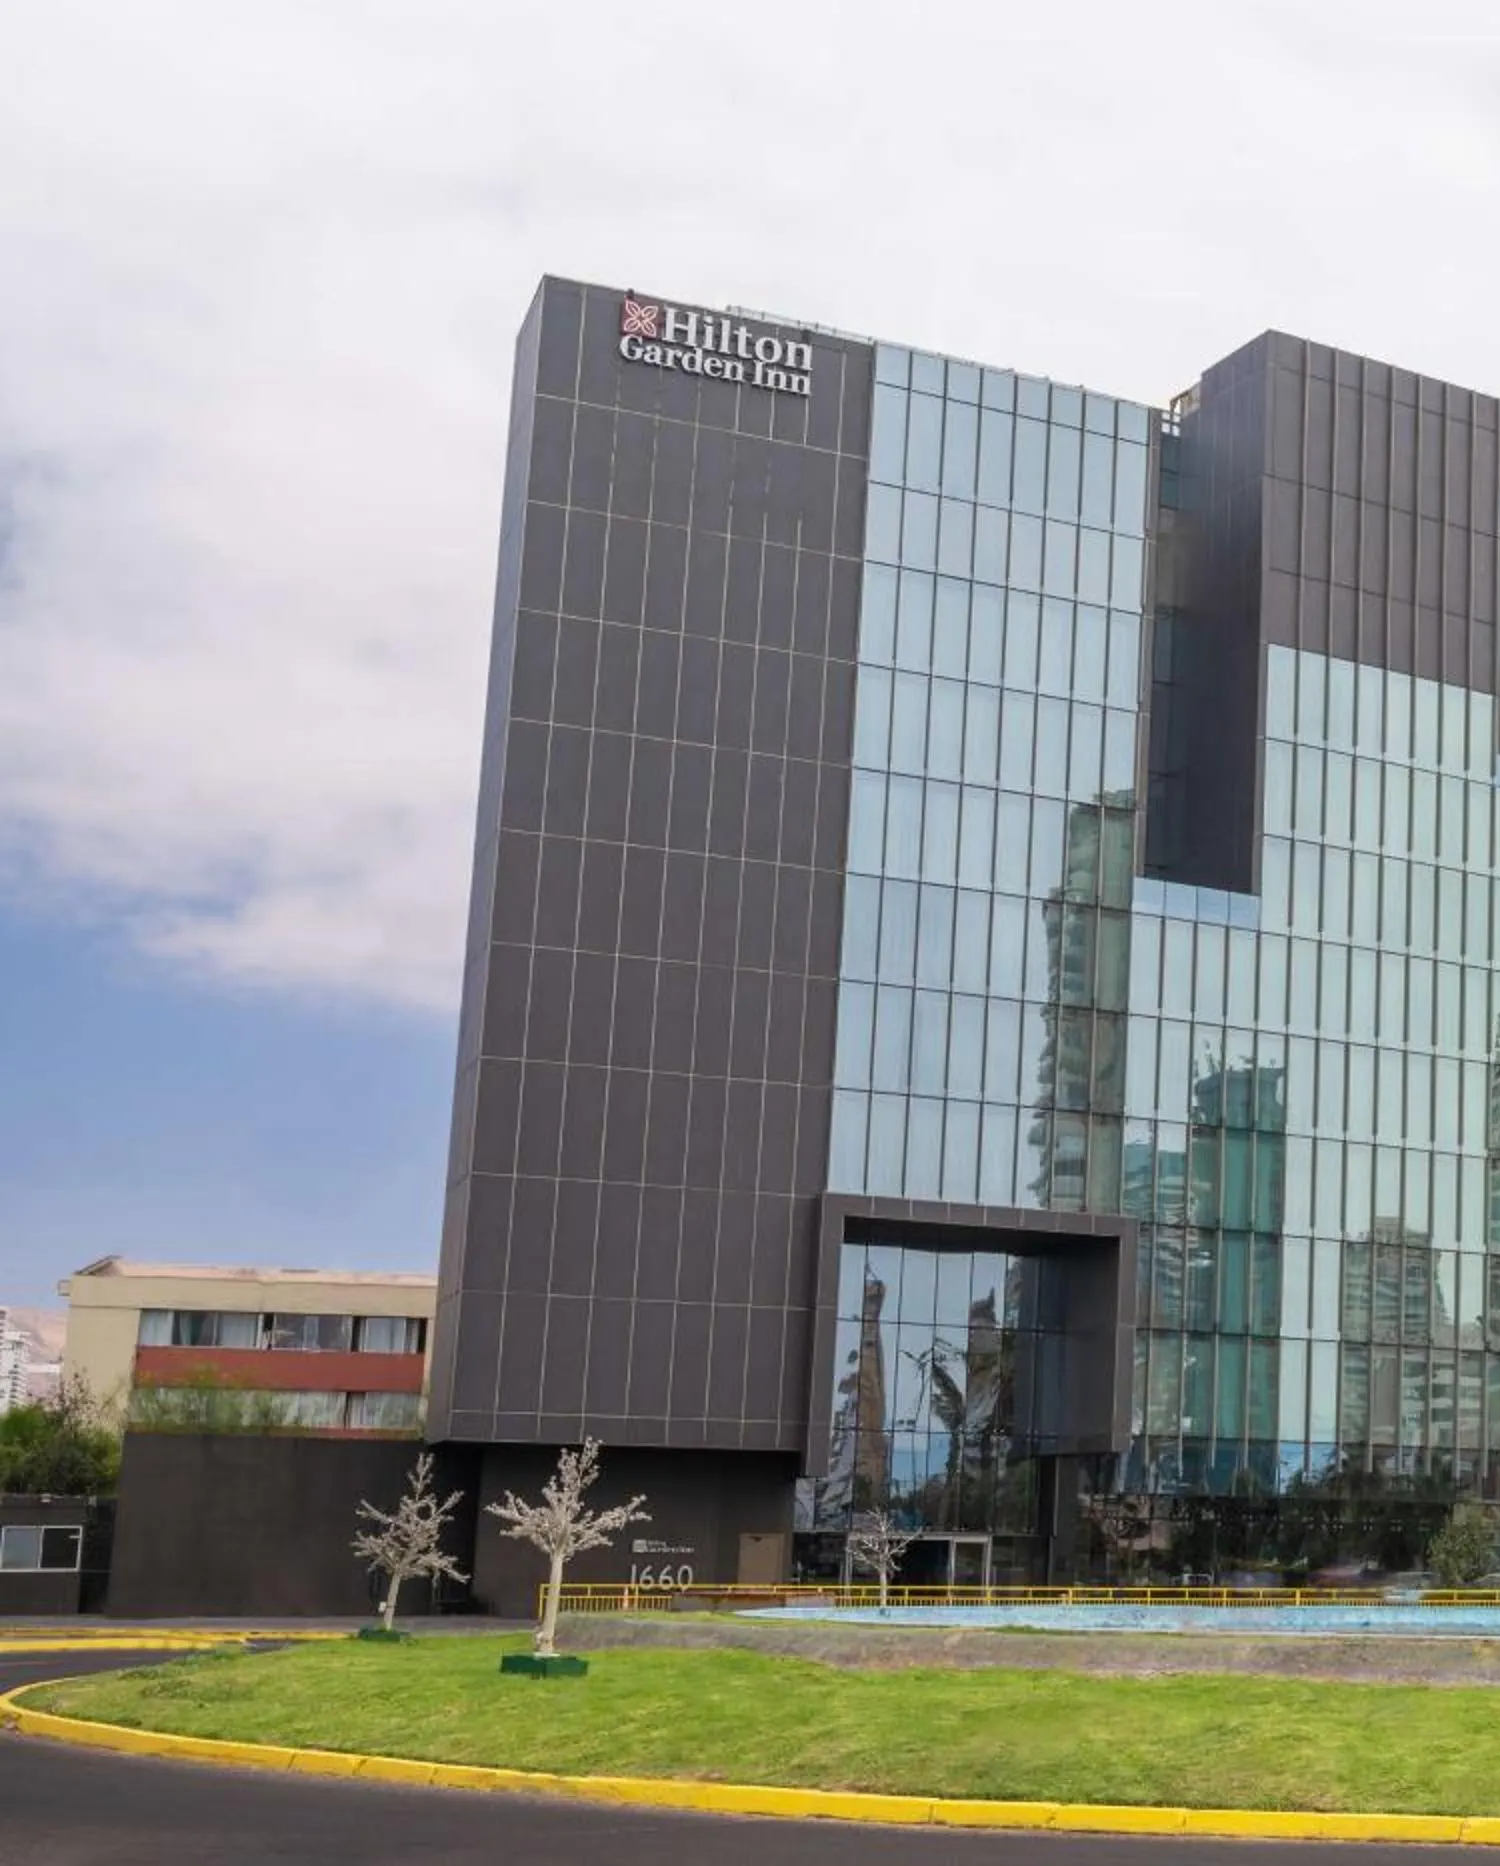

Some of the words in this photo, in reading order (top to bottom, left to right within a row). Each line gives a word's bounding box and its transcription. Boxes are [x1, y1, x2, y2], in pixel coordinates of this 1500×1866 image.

[620, 335, 746, 383] Garden
[752, 360, 811, 396] Inn
[662, 307, 812, 371] Hilton
[630, 1564, 694, 1591] 1660
